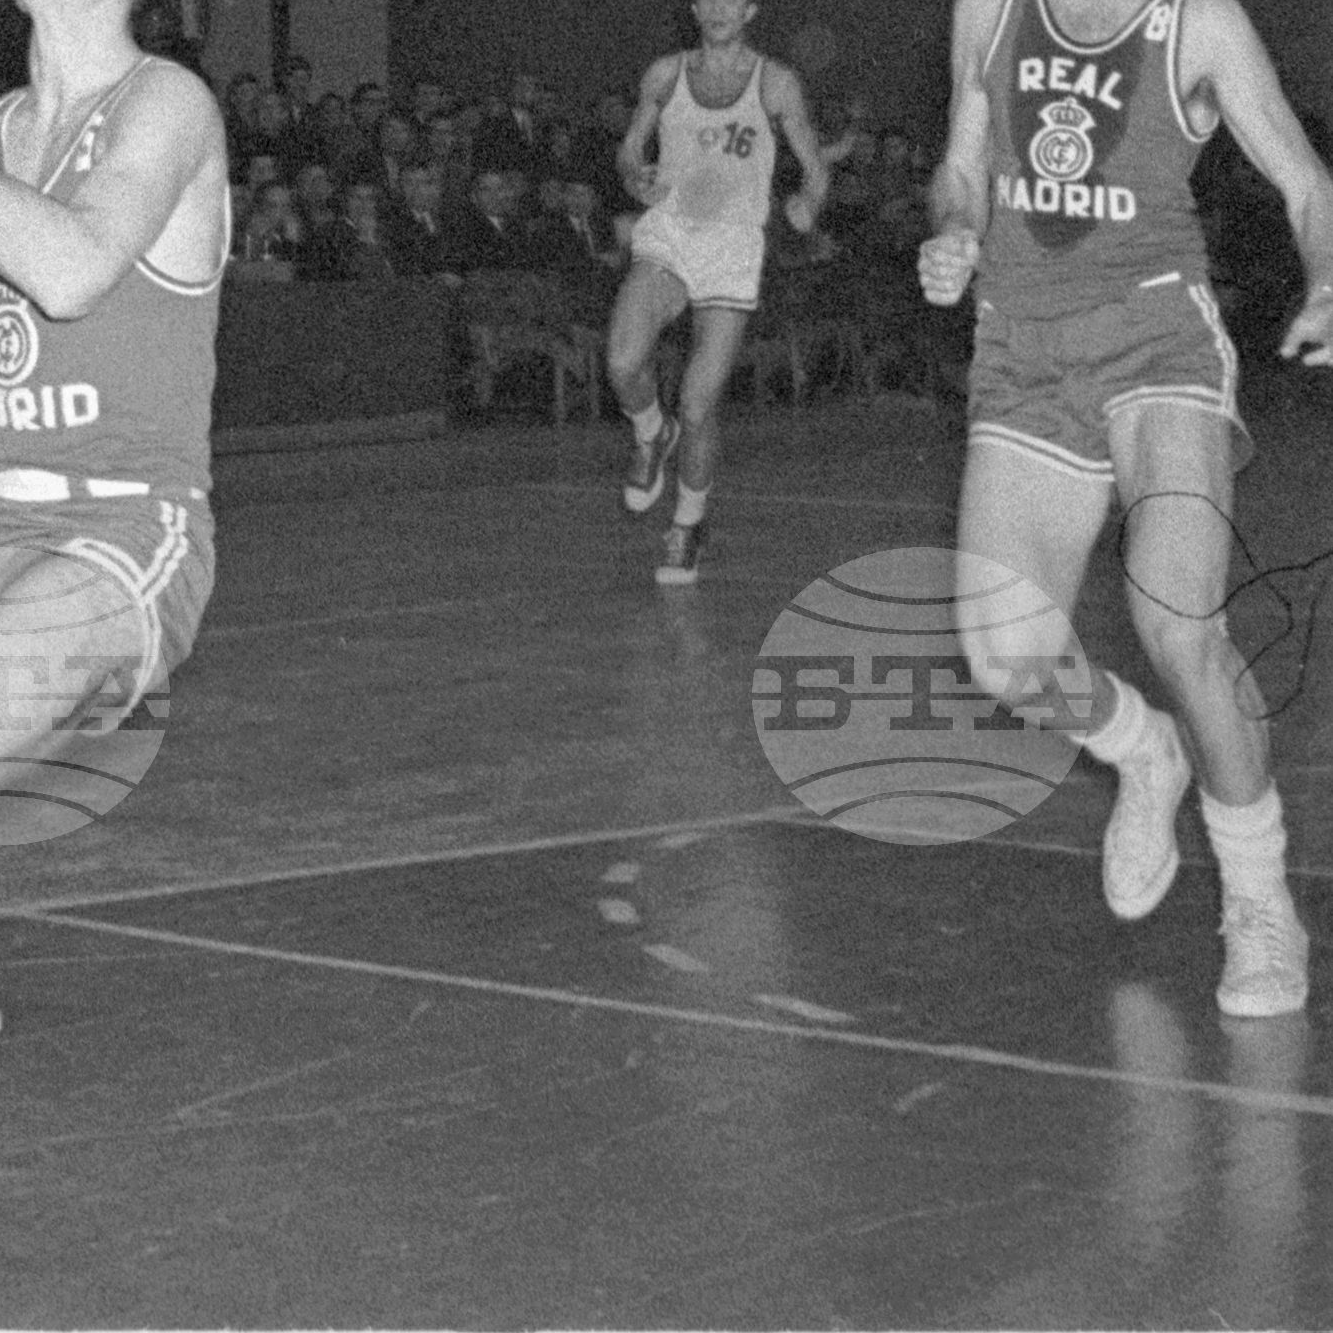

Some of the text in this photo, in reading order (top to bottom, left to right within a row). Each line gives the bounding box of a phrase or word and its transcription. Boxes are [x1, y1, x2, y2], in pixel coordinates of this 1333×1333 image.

[1144, 4, 1172, 42] 8
[1019, 56, 1124, 111] REAL
[723, 121, 757, 159] 16
